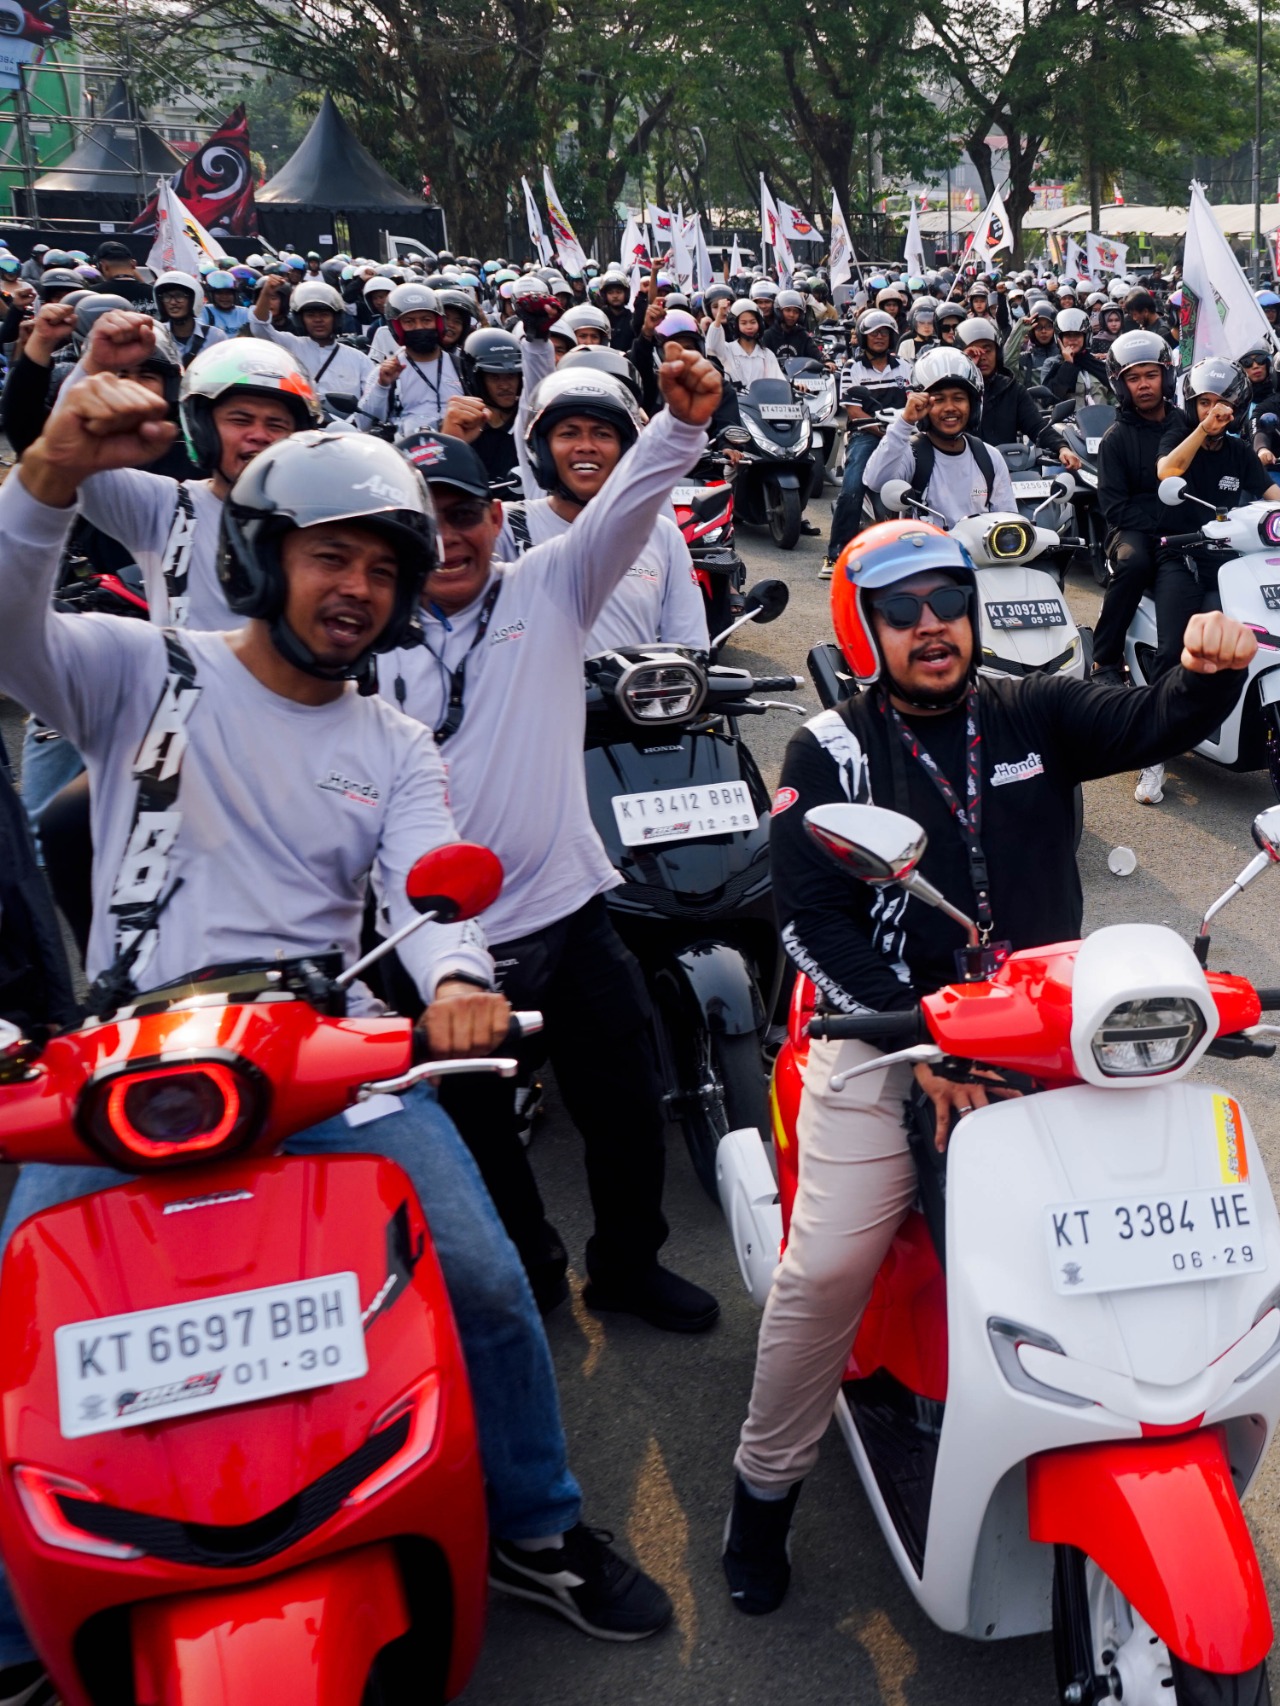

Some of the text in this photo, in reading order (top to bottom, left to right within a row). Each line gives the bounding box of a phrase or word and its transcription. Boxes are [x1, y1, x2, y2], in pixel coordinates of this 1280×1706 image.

[1263, 587, 1276, 598] KT
[988, 605, 1005, 618] KT
[1007, 602, 1037, 616] 3092
[489, 617, 531, 642] Hond
[642, 744, 685, 755] HONDA
[619, 787, 746, 818] KT 3412 BBH
[1052, 1193, 1251, 1248] KT 3384 HE
[77, 1290, 344, 1379] KT 6697 BBH
